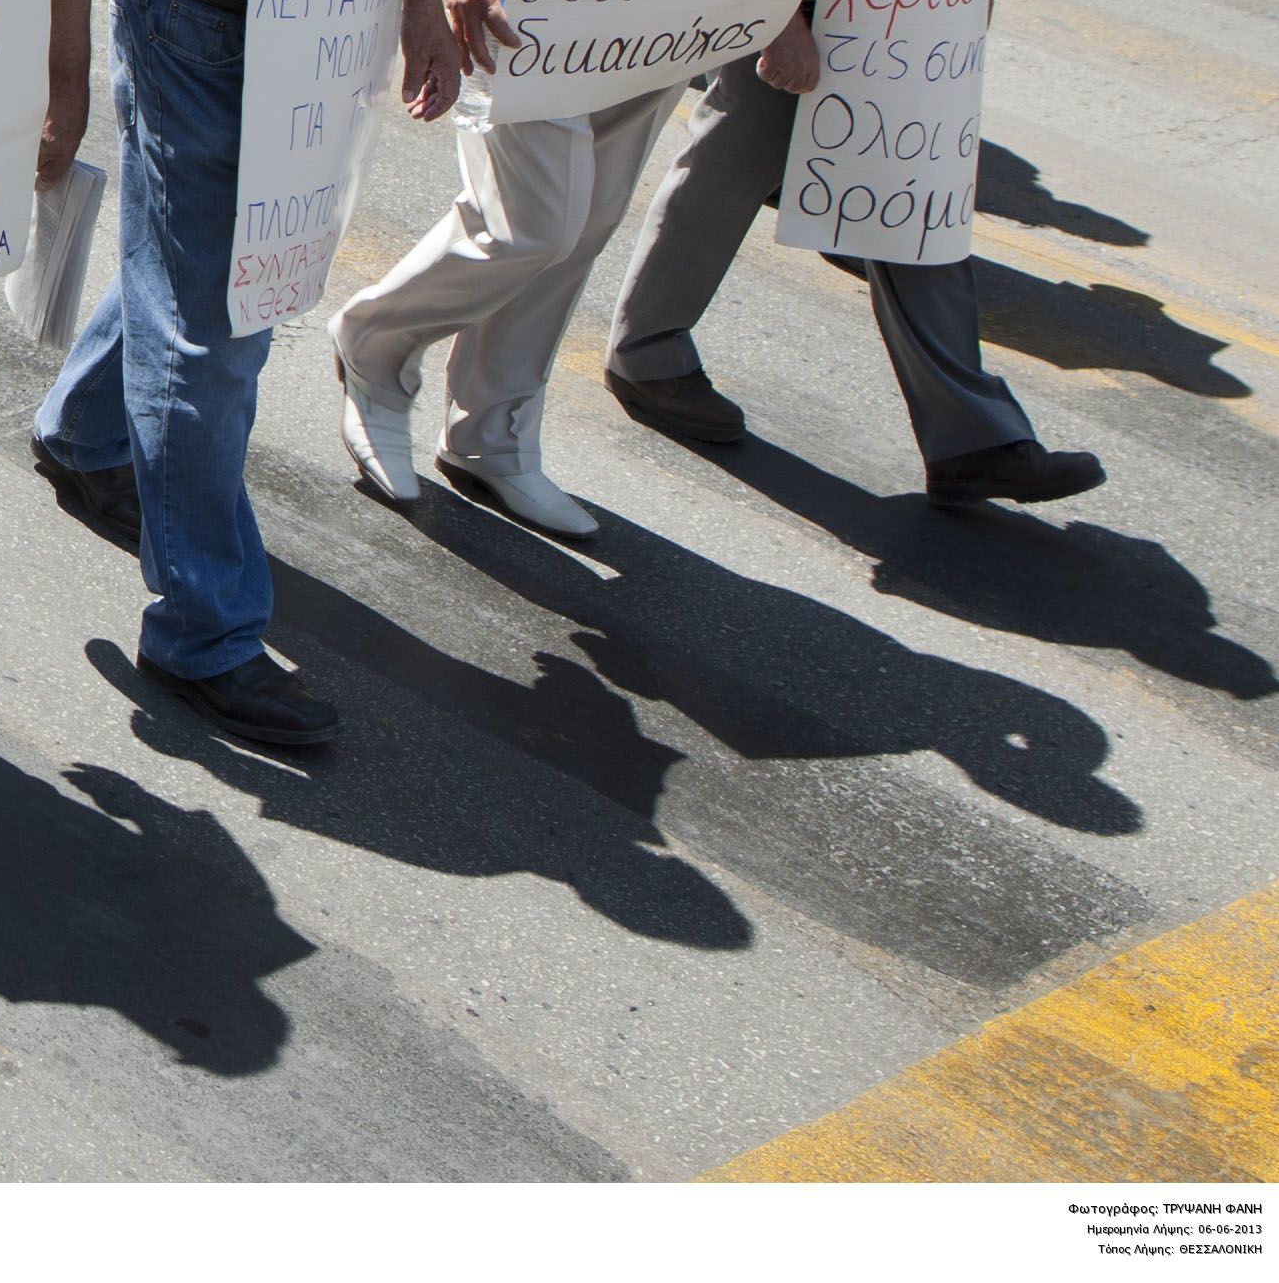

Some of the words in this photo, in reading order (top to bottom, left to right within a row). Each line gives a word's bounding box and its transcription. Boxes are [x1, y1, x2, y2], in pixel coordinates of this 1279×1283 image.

[824, 32, 910, 81] τις
[288, 99, 325, 153] ΓΙΑ
[811, 92, 942, 162] Ολοι
[247, 181, 342, 244] ΠΛΟΥΤΟ
